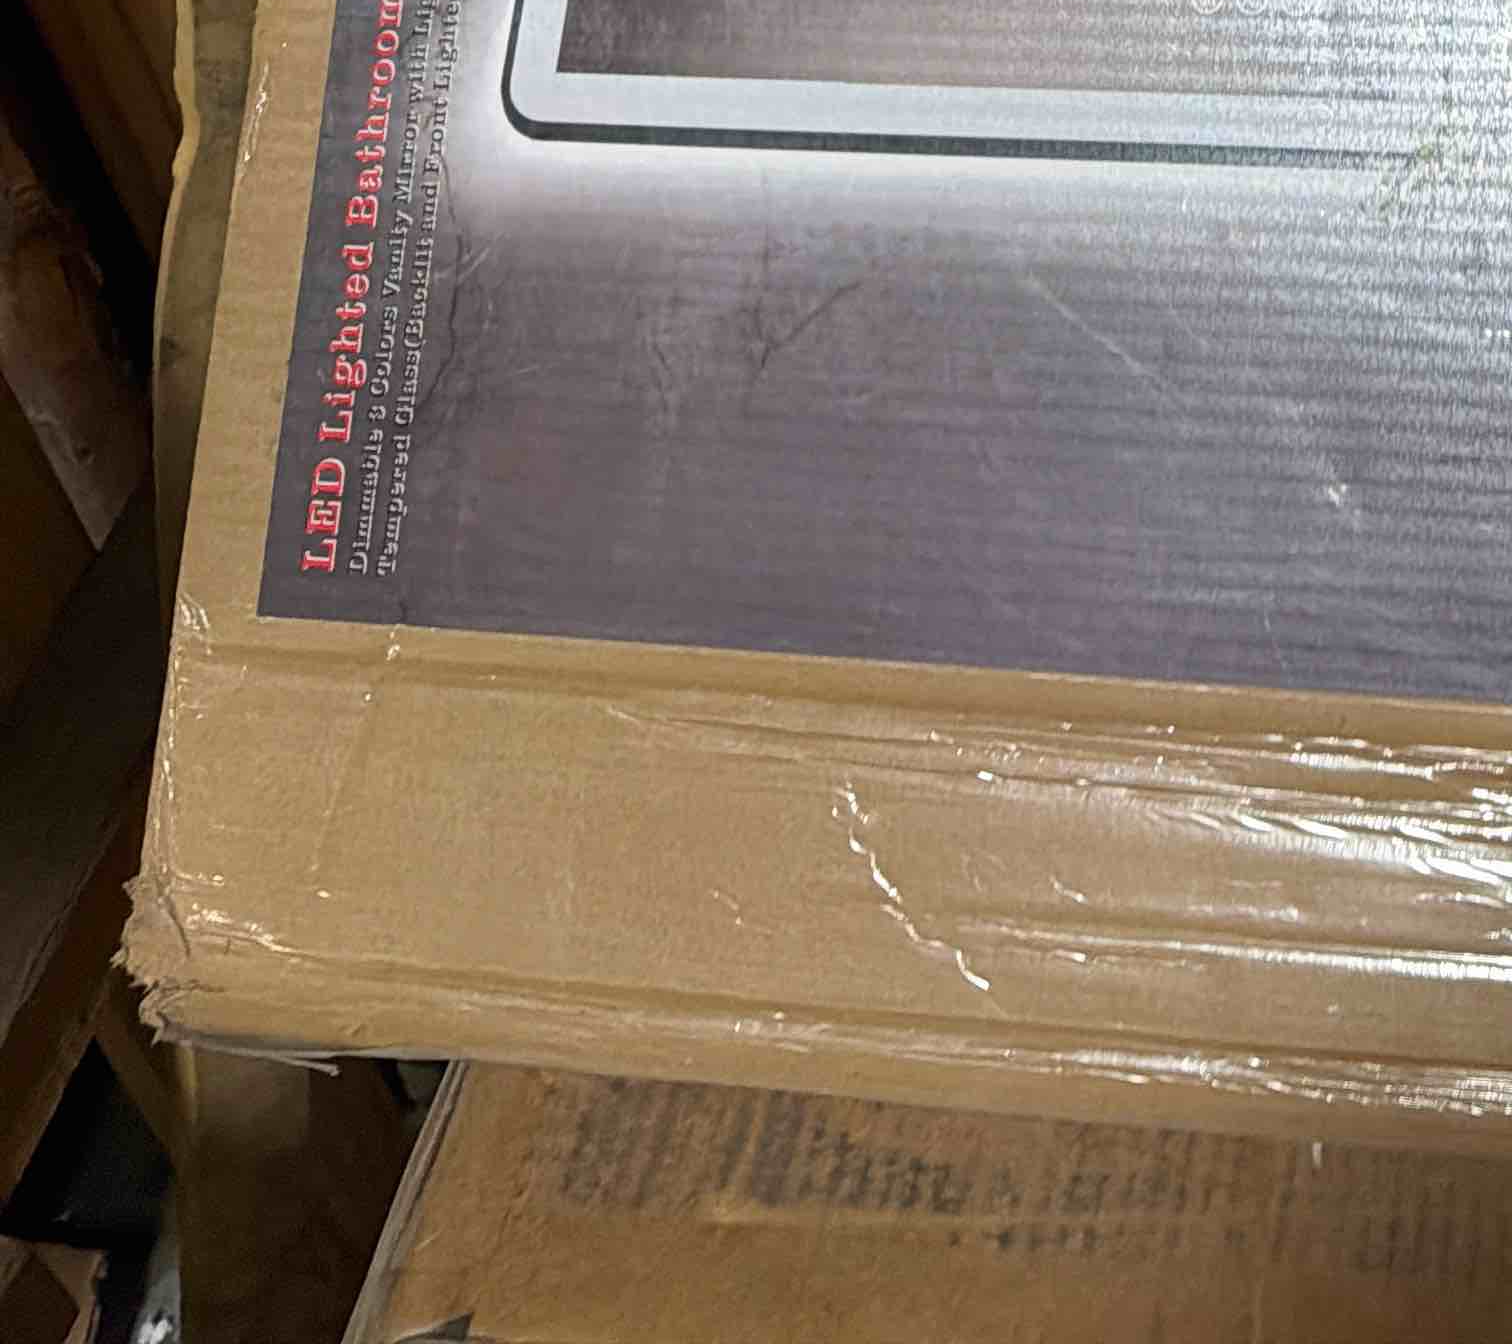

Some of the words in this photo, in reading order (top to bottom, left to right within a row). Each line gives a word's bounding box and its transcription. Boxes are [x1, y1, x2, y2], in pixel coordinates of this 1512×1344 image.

[407, 44, 431, 104] with
[393, 110, 420, 204] Mirror
[424, 97, 450, 176] Front
[420, 180, 441, 233] and
[382, 209, 413, 299] Vanity
[317, 240, 375, 444] Lighted
[370, 305, 399, 398] Colors
[299, 457, 347, 574] LED
[349, 427, 384, 576] Dimmable
[375, 433, 411, 577] Tempered
